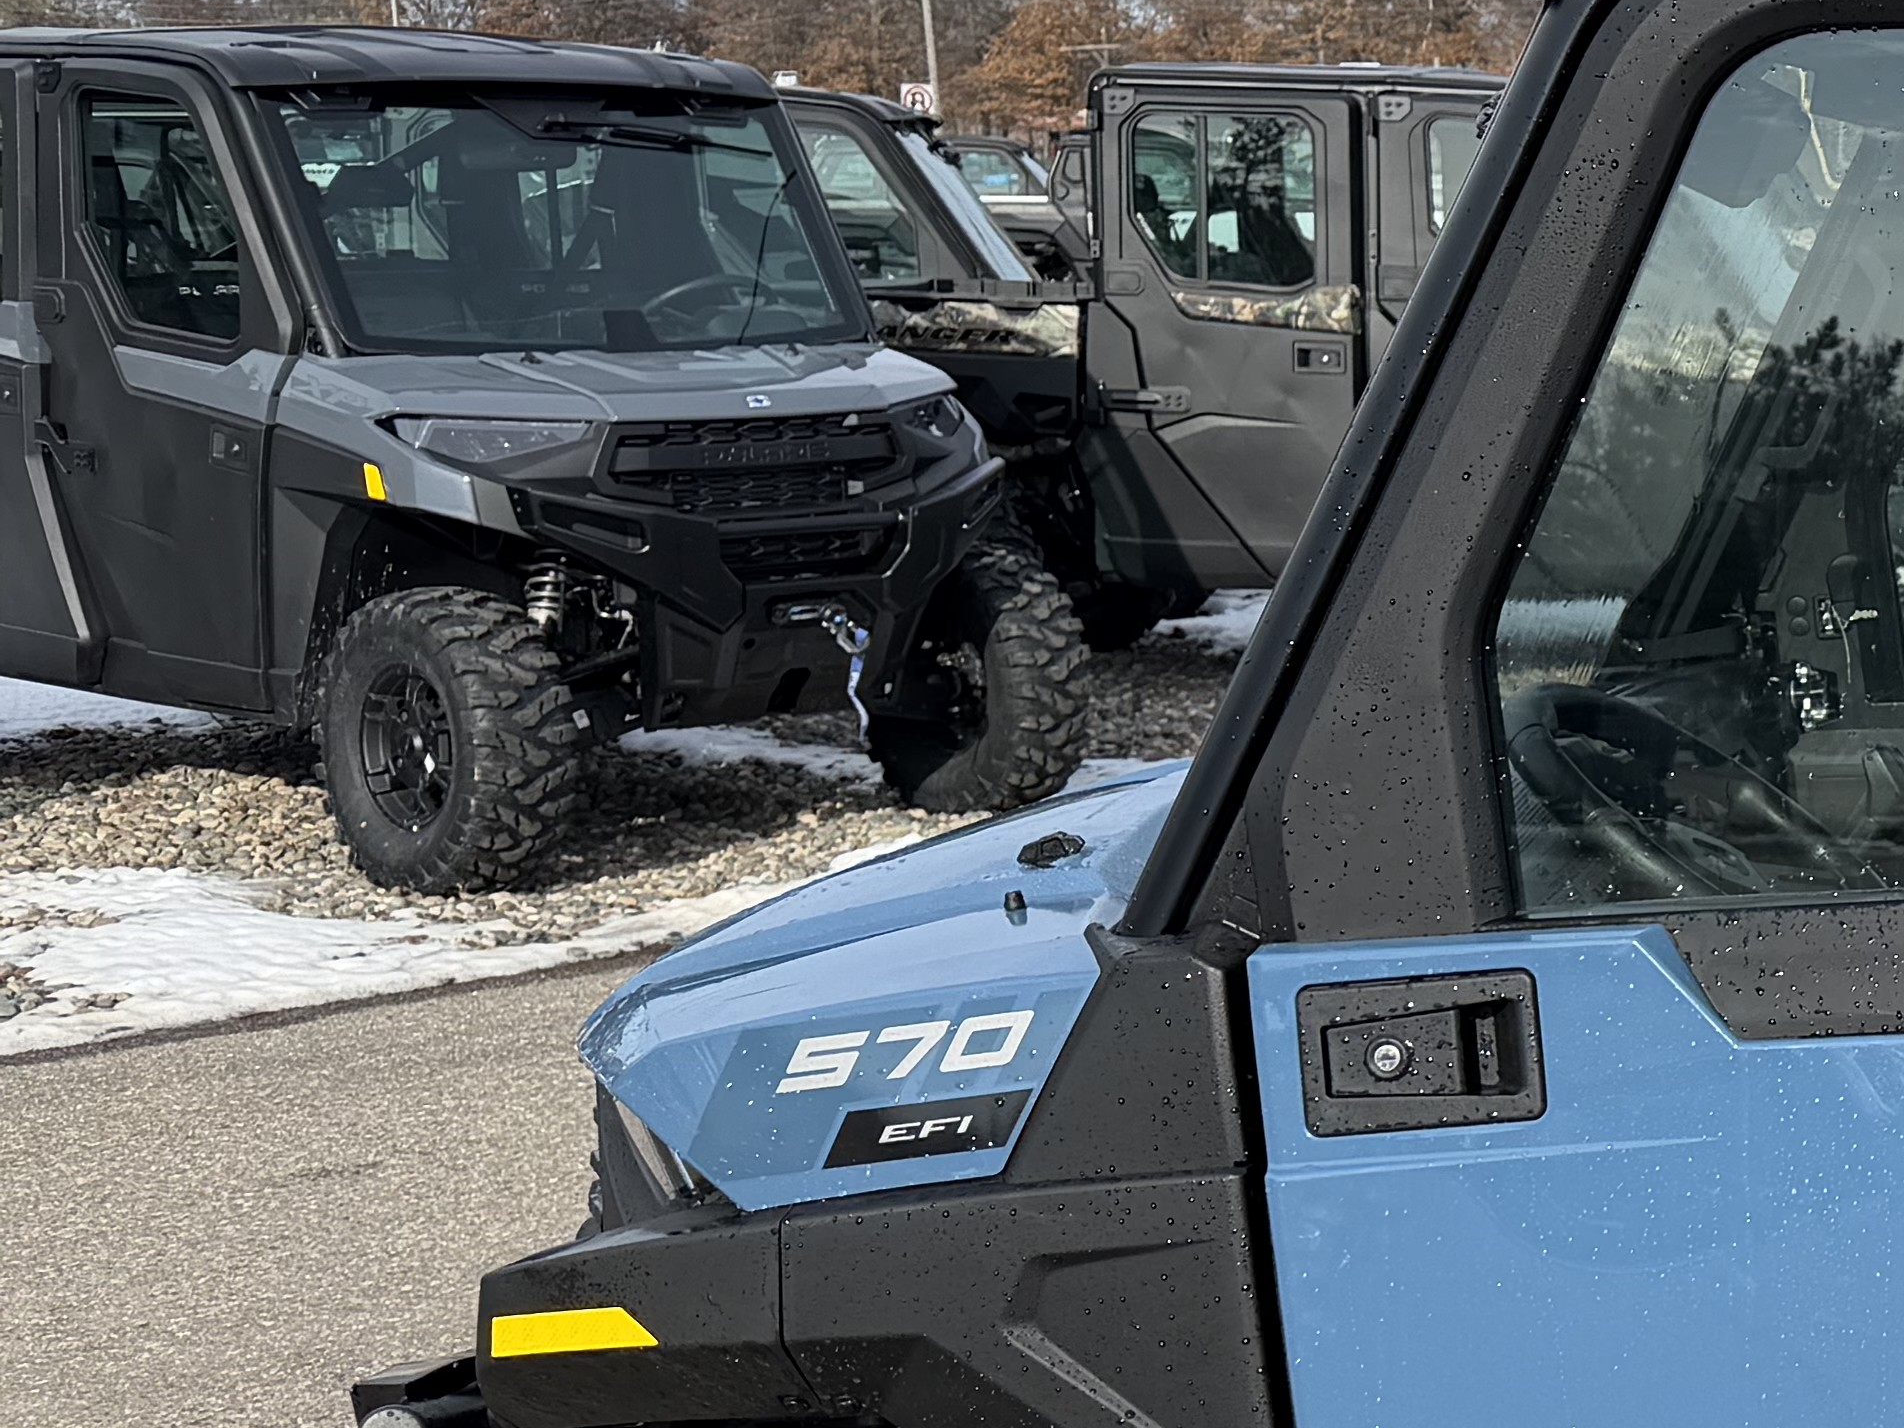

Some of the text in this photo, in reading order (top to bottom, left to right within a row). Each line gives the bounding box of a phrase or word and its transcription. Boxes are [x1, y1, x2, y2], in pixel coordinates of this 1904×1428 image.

[874, 324, 1017, 347] ANGER
[775, 1009, 1035, 1094] 570
[878, 1114, 974, 1144] EFI
